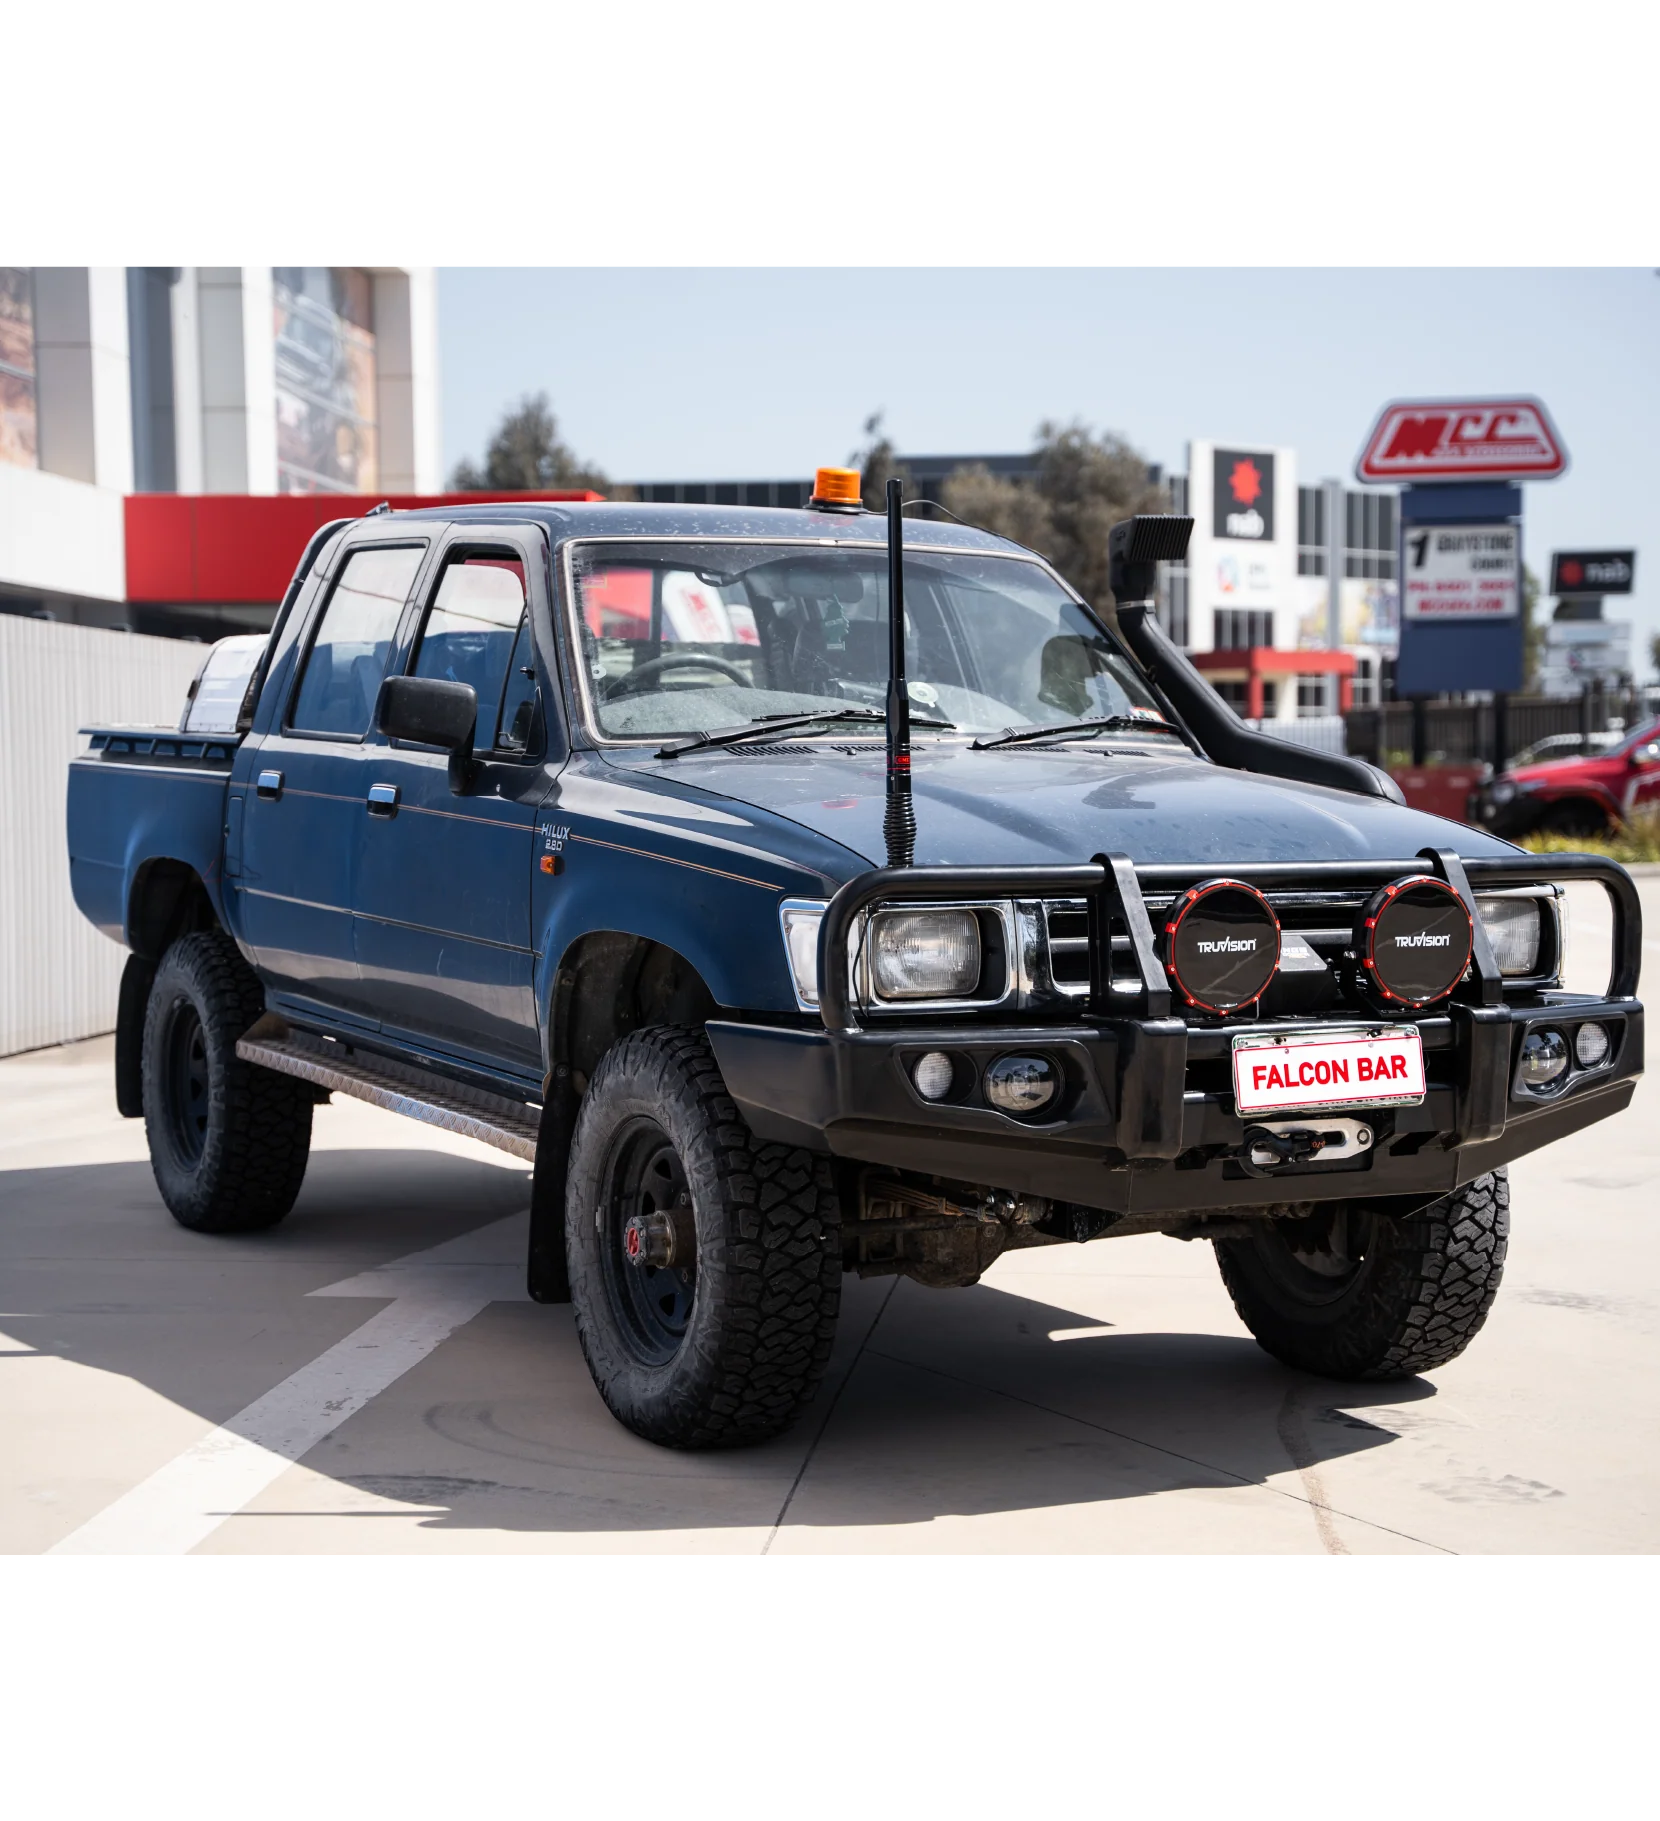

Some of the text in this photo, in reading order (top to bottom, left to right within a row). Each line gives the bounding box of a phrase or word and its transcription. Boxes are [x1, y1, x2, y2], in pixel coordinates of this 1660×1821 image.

[1382, 412, 1540, 459] MCC
[1410, 533, 1430, 567] 1
[1585, 558, 1630, 583] nab
[541, 823, 570, 840] HILUX
[1252, 1055, 1408, 1090] FALCON BAR
